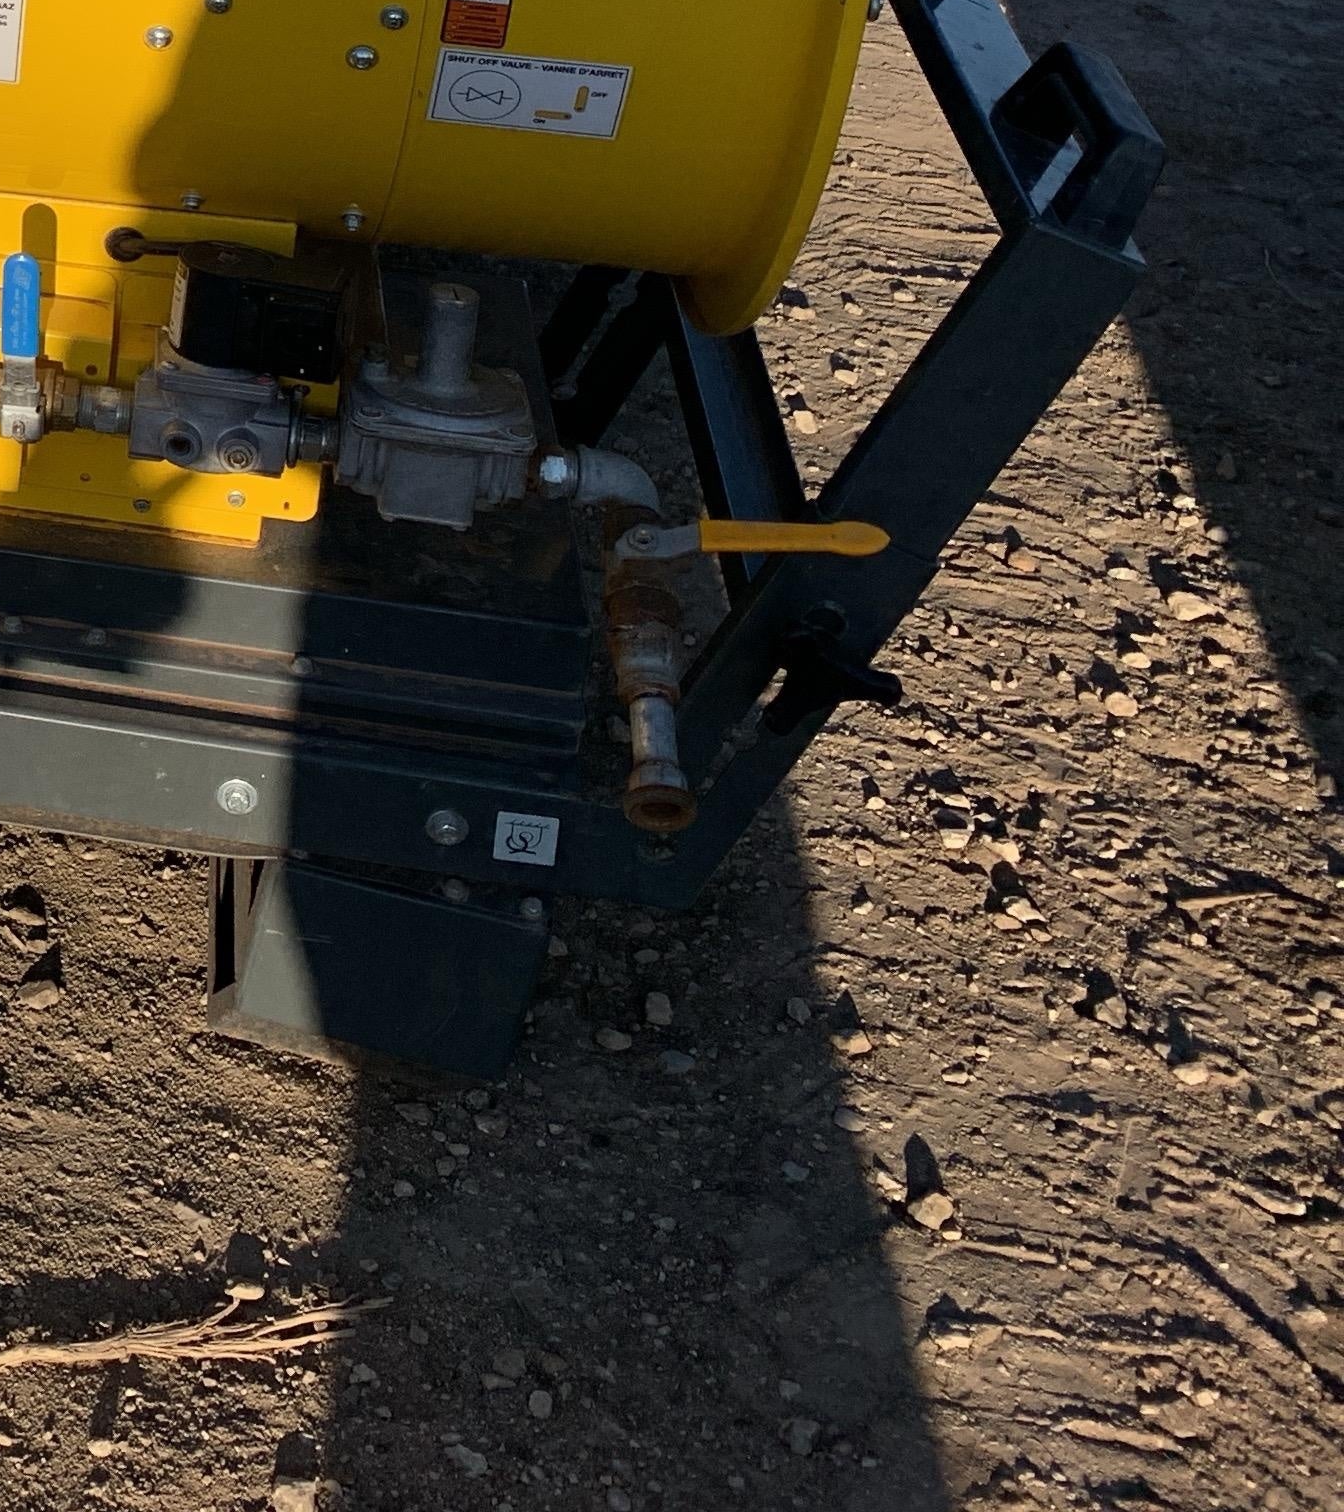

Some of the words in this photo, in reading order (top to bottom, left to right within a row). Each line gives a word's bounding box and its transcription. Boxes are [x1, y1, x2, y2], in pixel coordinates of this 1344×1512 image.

[448, 54, 474, 65] SHUT
[478, 57, 498, 67] OFF
[501, 59, 531, 70] VALVE
[541, 62, 576, 73] VANNE
